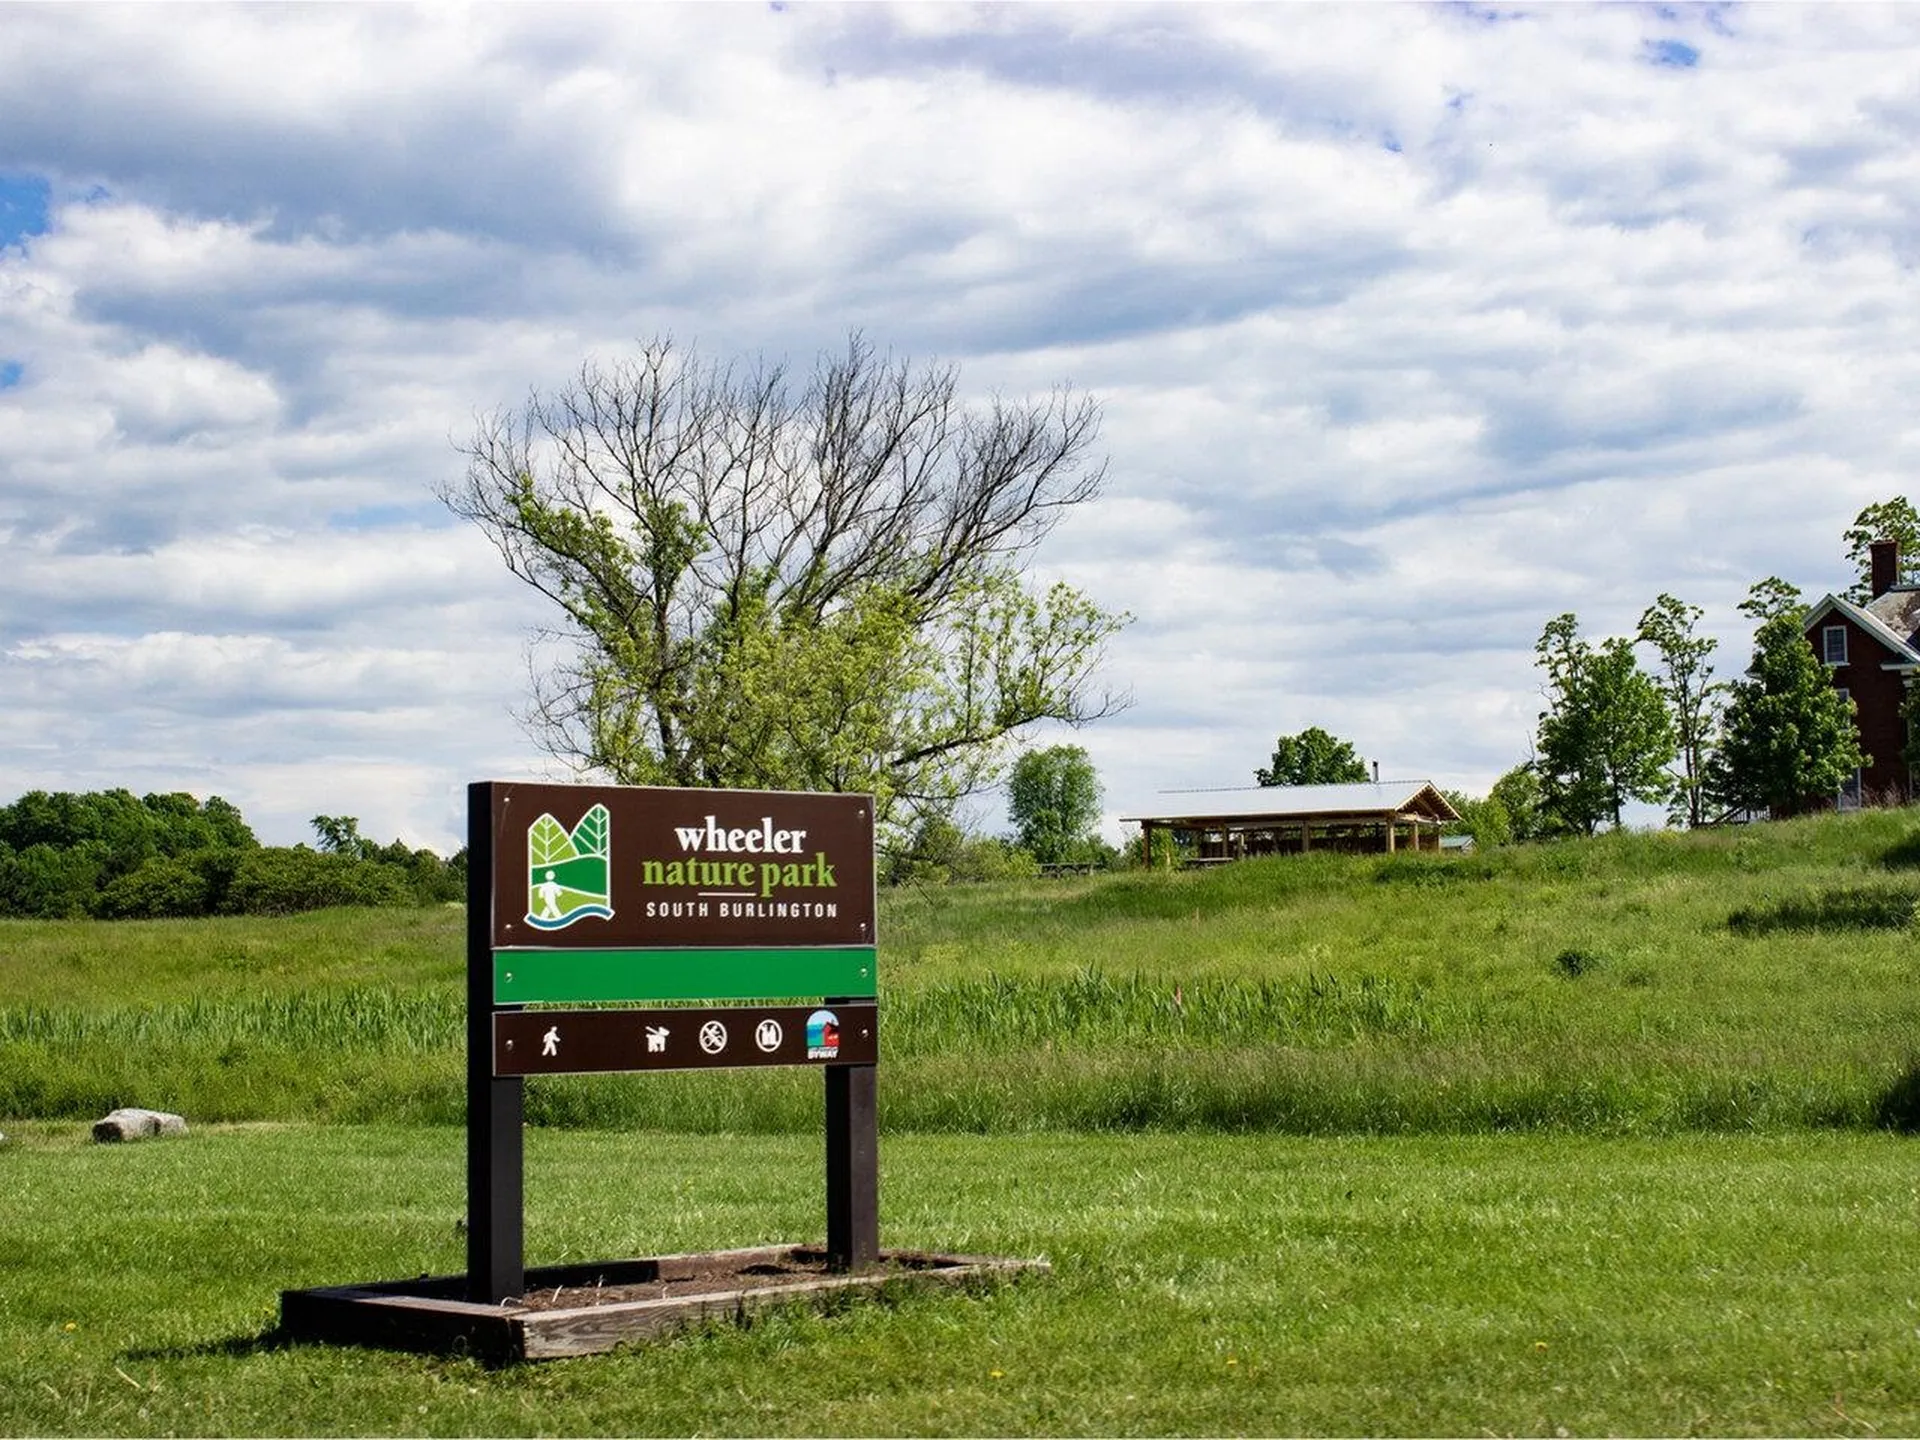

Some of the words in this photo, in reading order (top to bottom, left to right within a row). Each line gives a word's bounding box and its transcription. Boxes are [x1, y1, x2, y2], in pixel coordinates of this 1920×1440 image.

[674, 815, 806, 853] wheeler
[642, 857, 755, 887] nature
[760, 851, 837, 898] park
[646, 901, 709, 917] SOUTH
[719, 902, 837, 918] BURLINGTON
